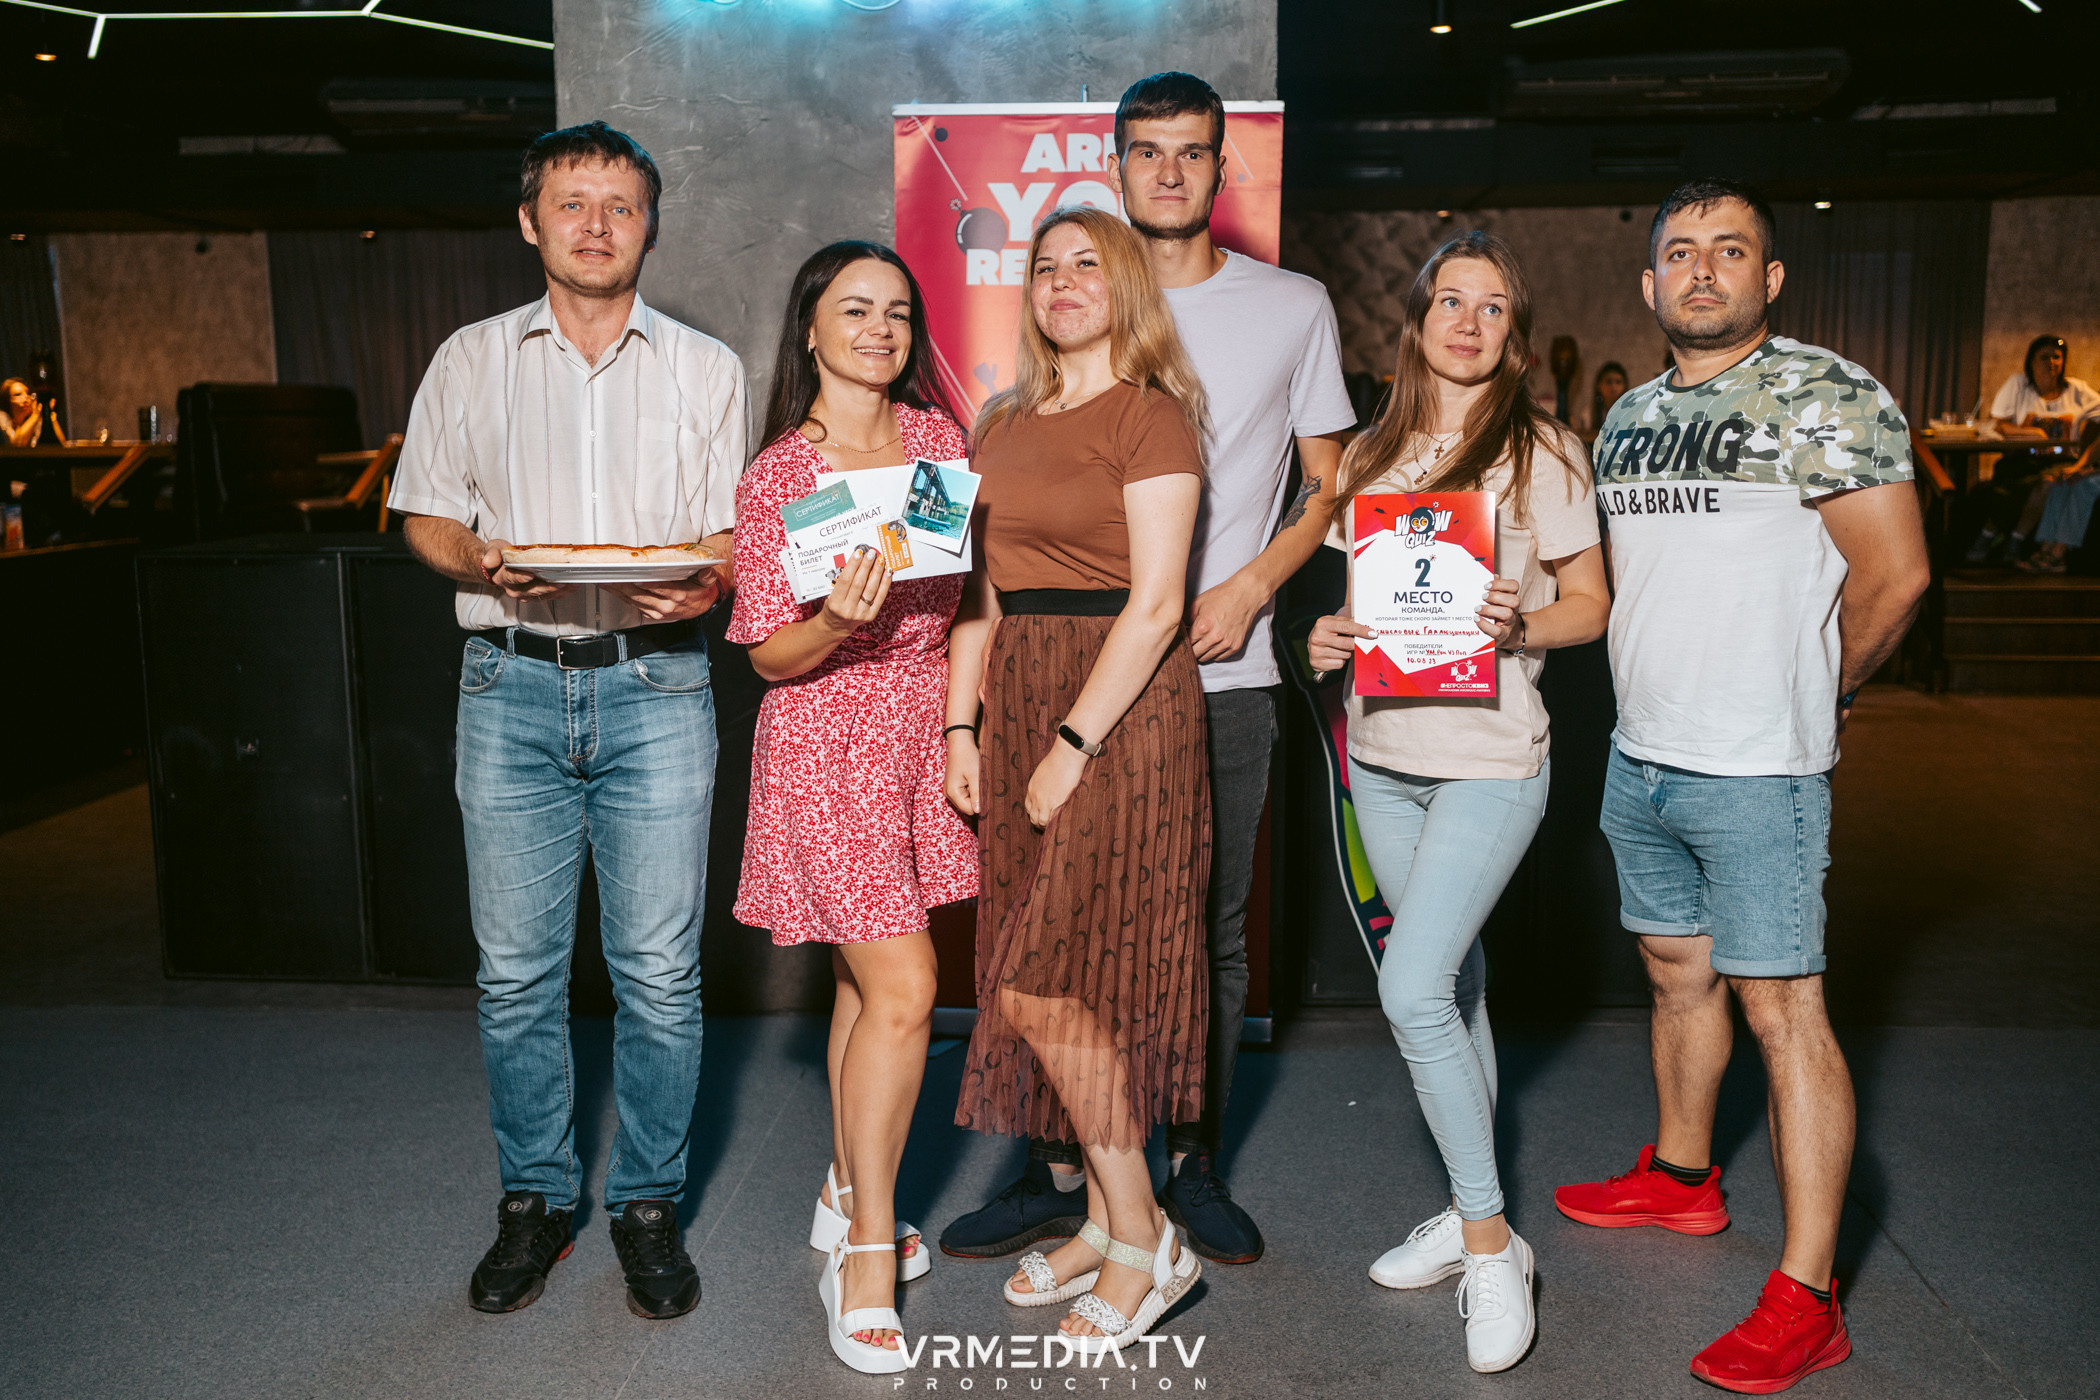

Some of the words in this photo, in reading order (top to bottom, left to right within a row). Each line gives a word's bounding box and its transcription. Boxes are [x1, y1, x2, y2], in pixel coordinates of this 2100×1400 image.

[987, 180, 1131, 242] YO
[796, 493, 841, 518] СЕРТИФИКАТ
[819, 506, 883, 538] СЕРТИФИКАТ
[798, 538, 849, 559] ПОДАРОЧНЫЙ
[1405, 531, 1436, 549] QUIZ
[800, 555, 823, 567] БИЛЕТ
[1415, 558, 1431, 588] 2
[1393, 591, 1453, 604] МЕСТО
